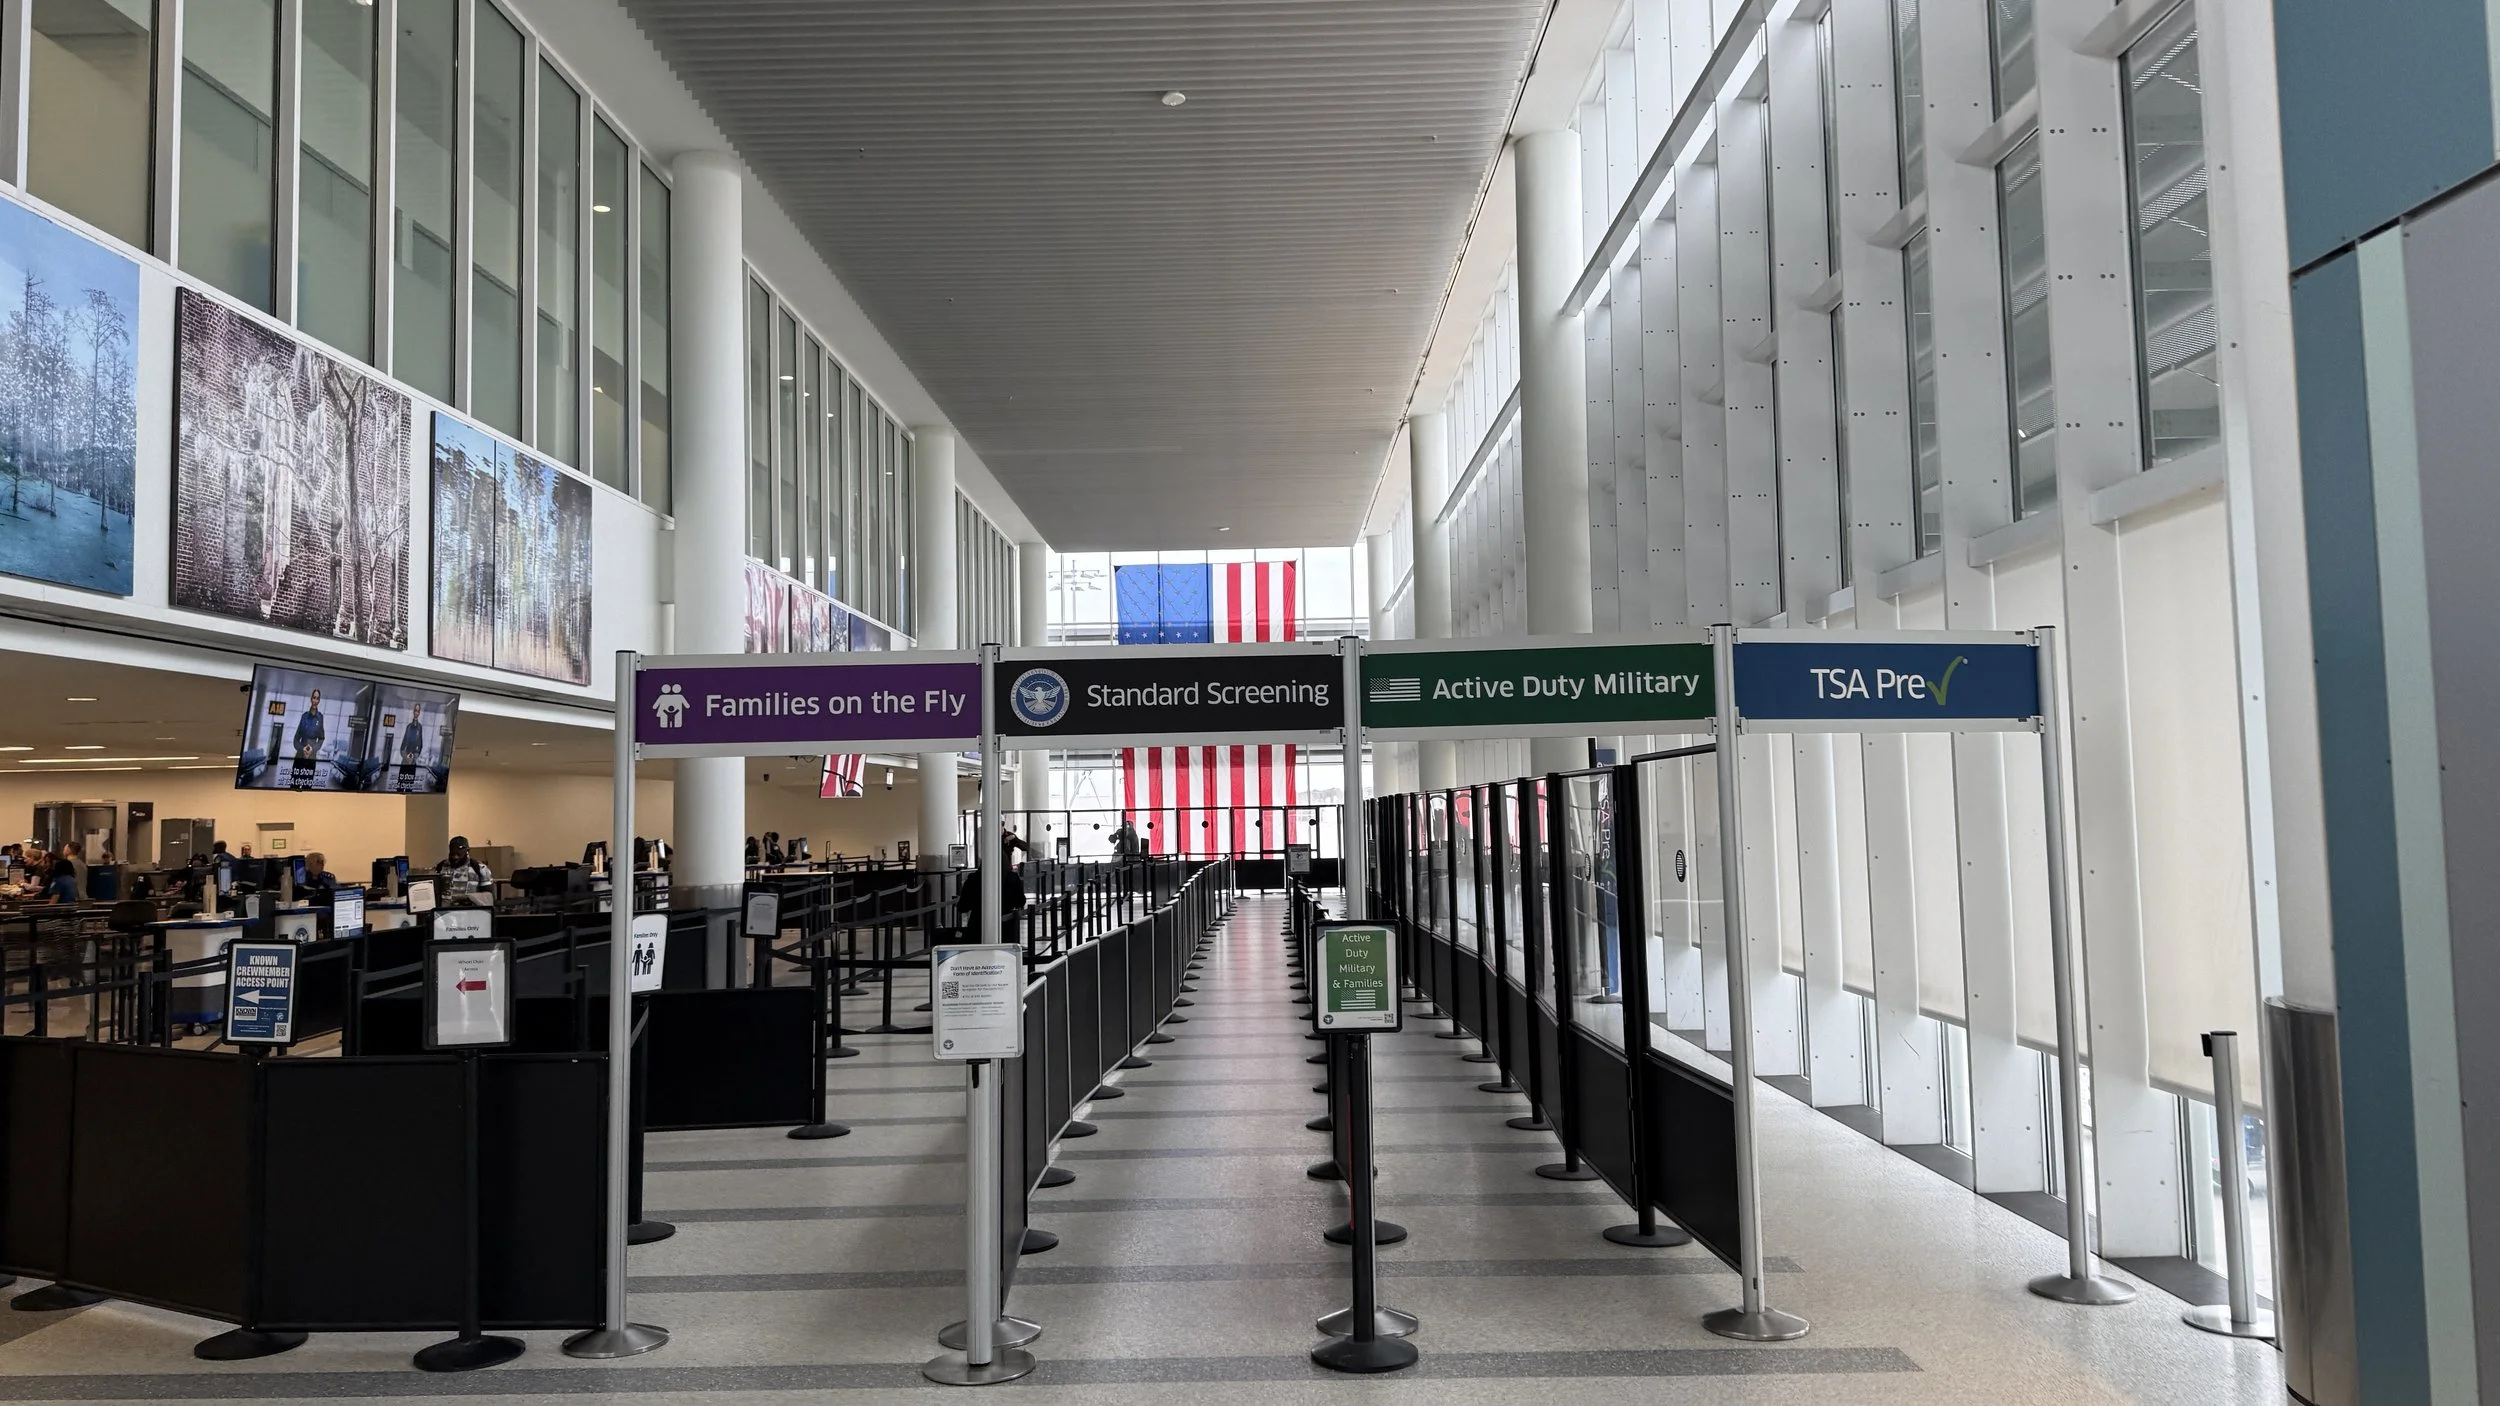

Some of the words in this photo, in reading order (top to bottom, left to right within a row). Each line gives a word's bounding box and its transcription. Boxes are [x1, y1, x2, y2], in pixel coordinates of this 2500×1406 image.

[1432, 676, 1513, 700] Active
[1524, 675, 1585, 702] Duty
[1595, 671, 1699, 701] Military
[1810, 668, 1869, 699] TSA
[1877, 668, 1926, 699] Pre
[1087, 682, 1198, 707] Standard
[1207, 680, 1329, 709] Screening
[707, 692, 819, 717] Families
[829, 696, 861, 715] on
[872, 691, 914, 714] the
[926, 690, 965, 717] Fly
[1601, 828, 1612, 860] Pre
[1341, 933, 1372, 943] Active
[1345, 949, 1369, 959] Duty
[249, 955, 278, 966] KNOWN
[236, 966, 291, 977] CREWMEMBER
[1339, 964, 1376, 975] Military
[235, 977, 265, 988] ACCESS
[266, 978, 290, 988] POINT
[1332, 979, 1341, 989] &
[1344, 979, 1384, 988] Families
